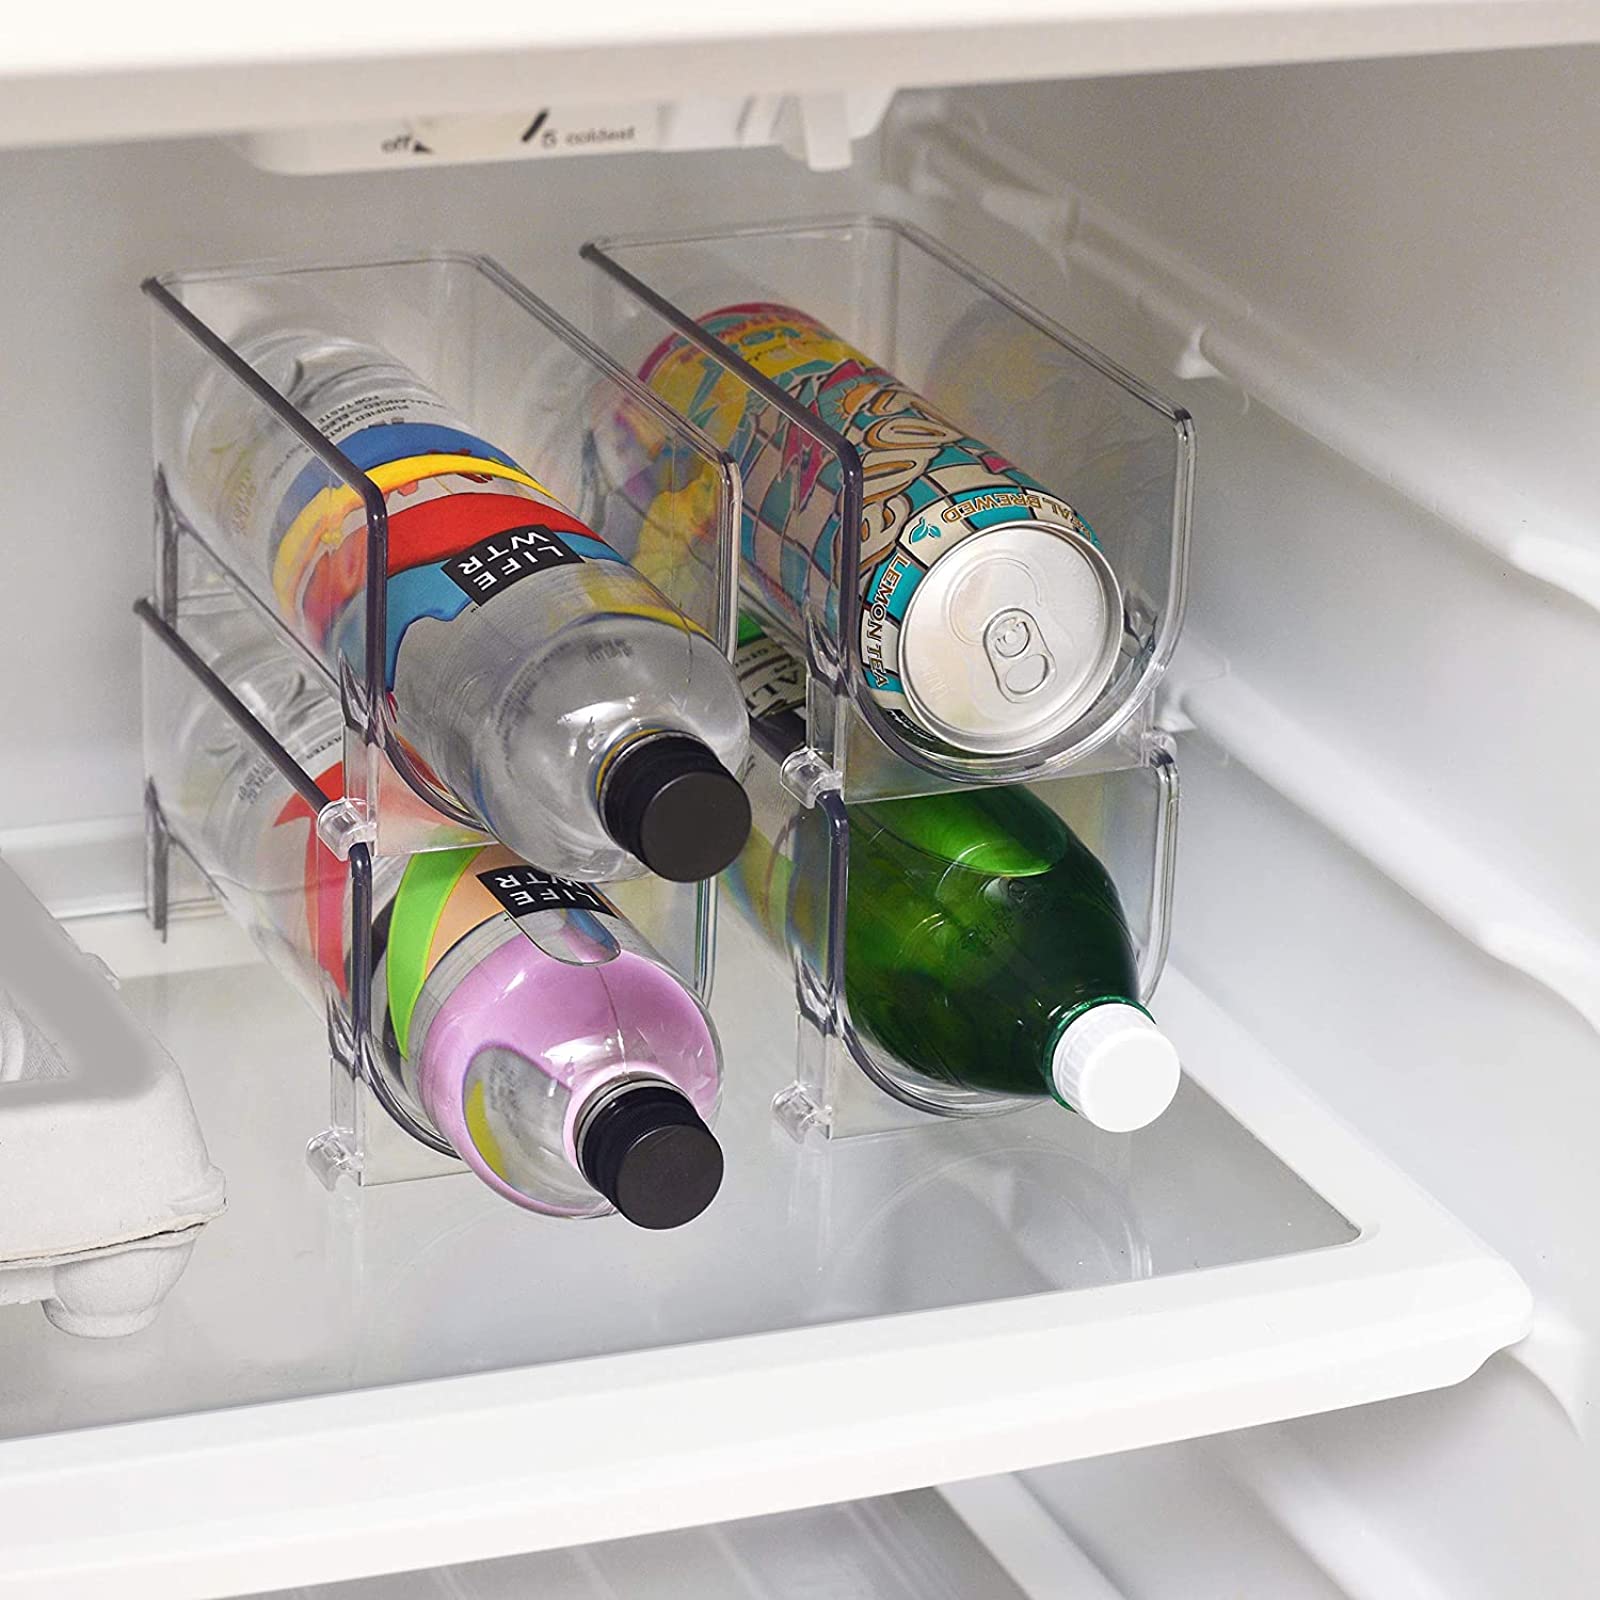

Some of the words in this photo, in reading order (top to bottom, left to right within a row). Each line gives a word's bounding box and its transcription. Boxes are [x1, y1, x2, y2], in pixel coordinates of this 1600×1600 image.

[941, 493, 1042, 524] BREWED
[457, 531, 550, 576] WTR
[473, 545, 564, 591] LIFE
[866, 552, 912, 642] LEMON
[866, 643, 889, 688] TEA
[509, 888, 600, 907] LIFE
